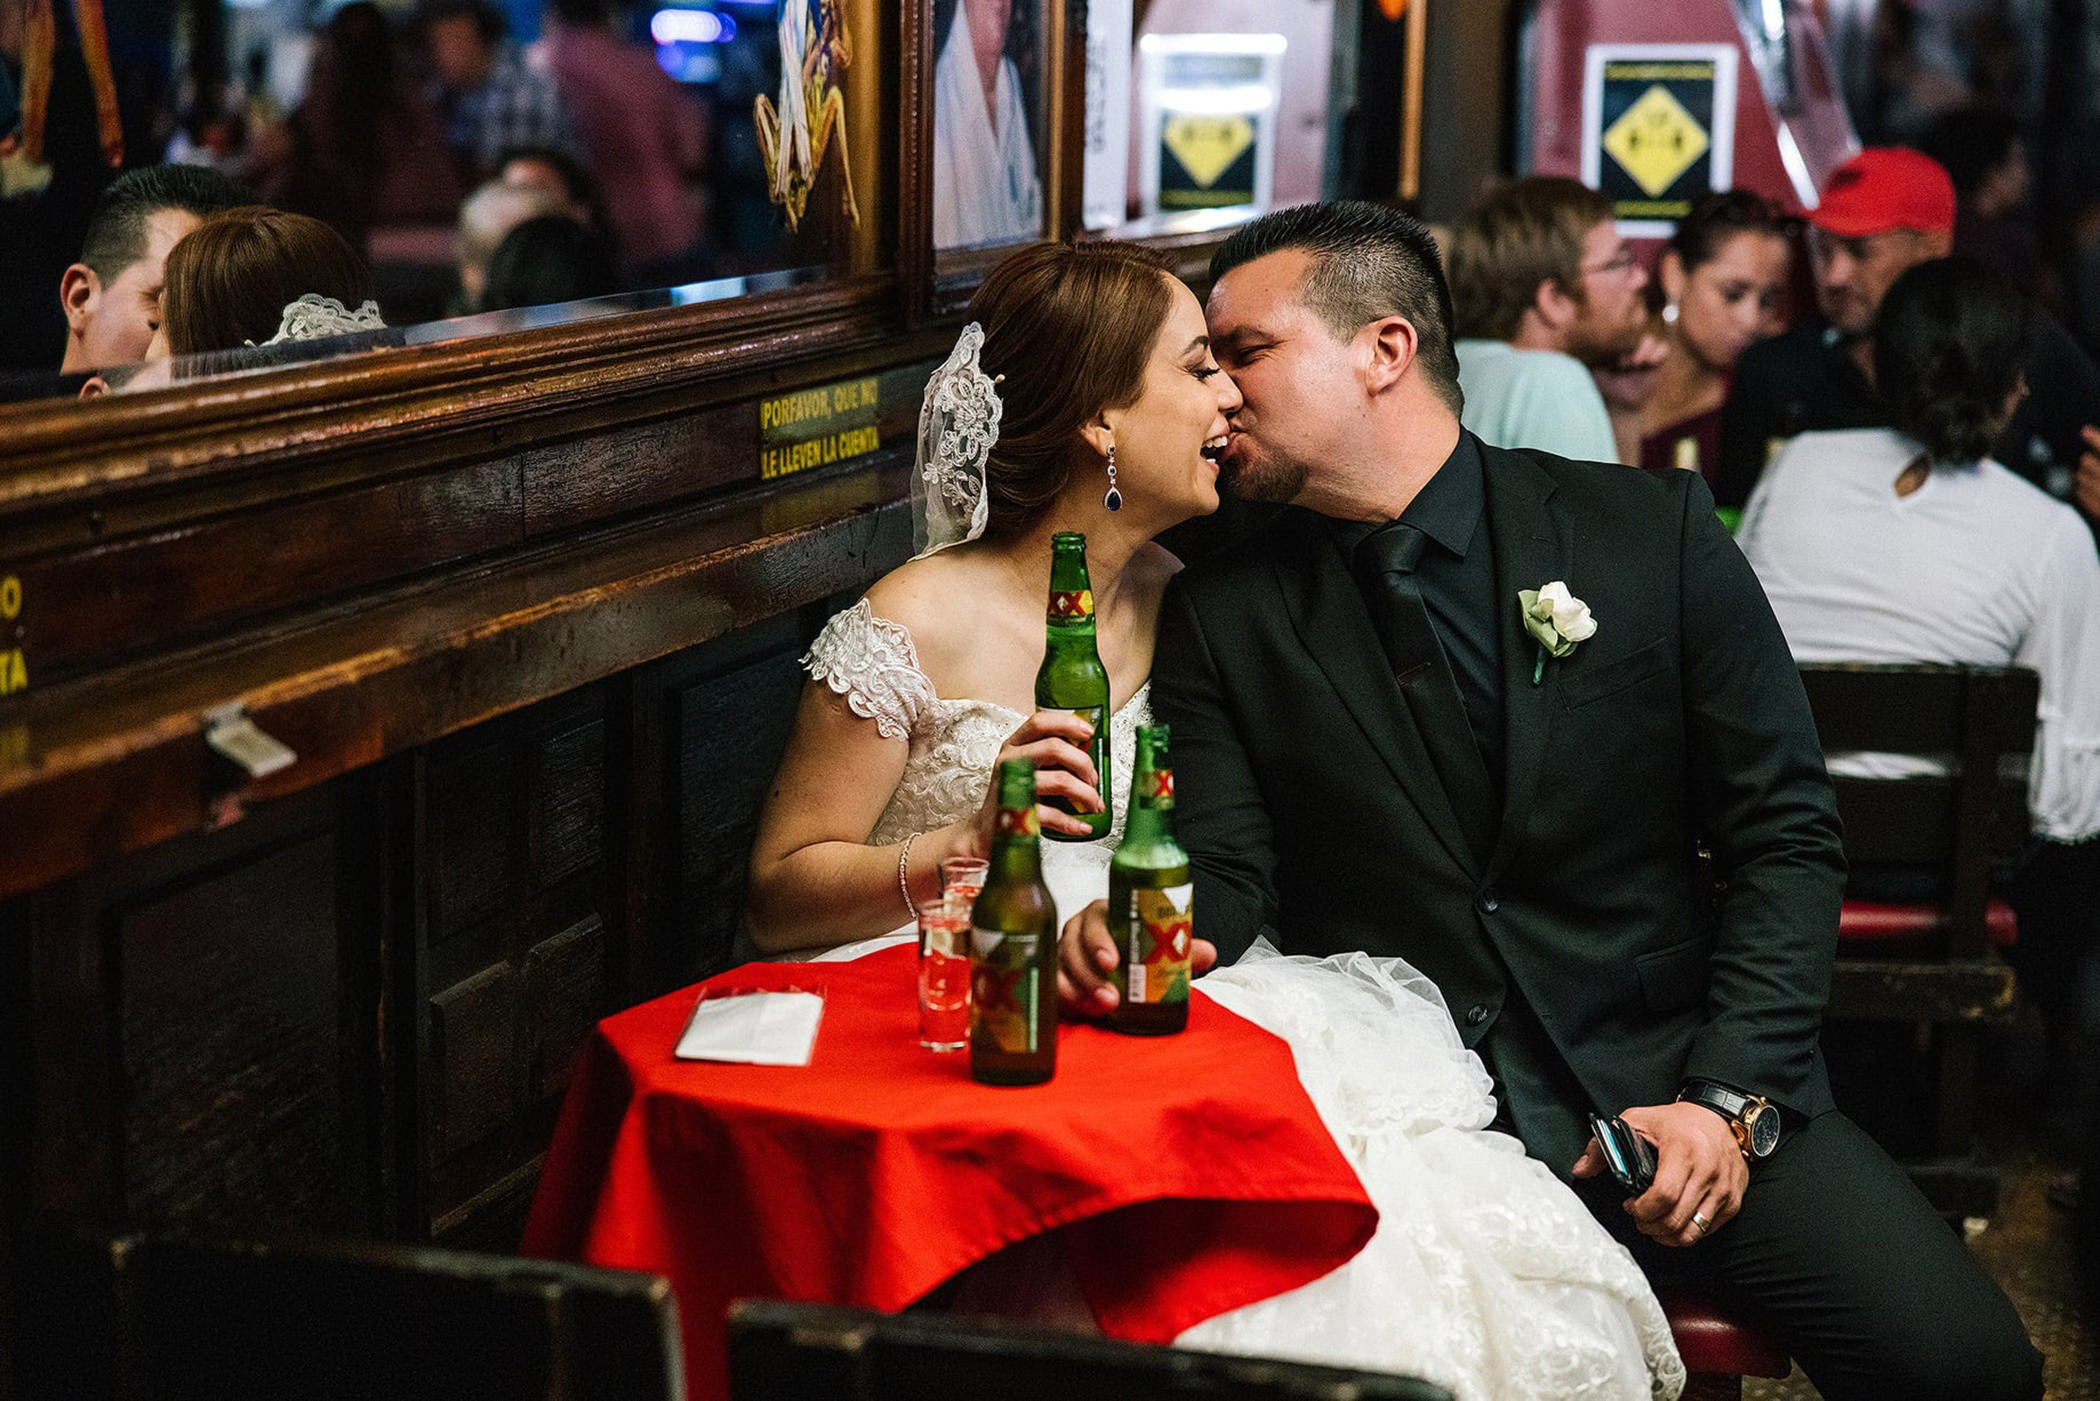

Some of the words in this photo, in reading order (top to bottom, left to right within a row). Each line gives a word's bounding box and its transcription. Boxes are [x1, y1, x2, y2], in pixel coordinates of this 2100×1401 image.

[761, 390, 832, 430] PORFAVOR,
[834, 383, 858, 412] QUE
[762, 450, 777, 479] LE
[780, 440, 821, 476] LLEVEN
[823, 435, 837, 463] LA
[839, 426, 879, 459] CUENTA
